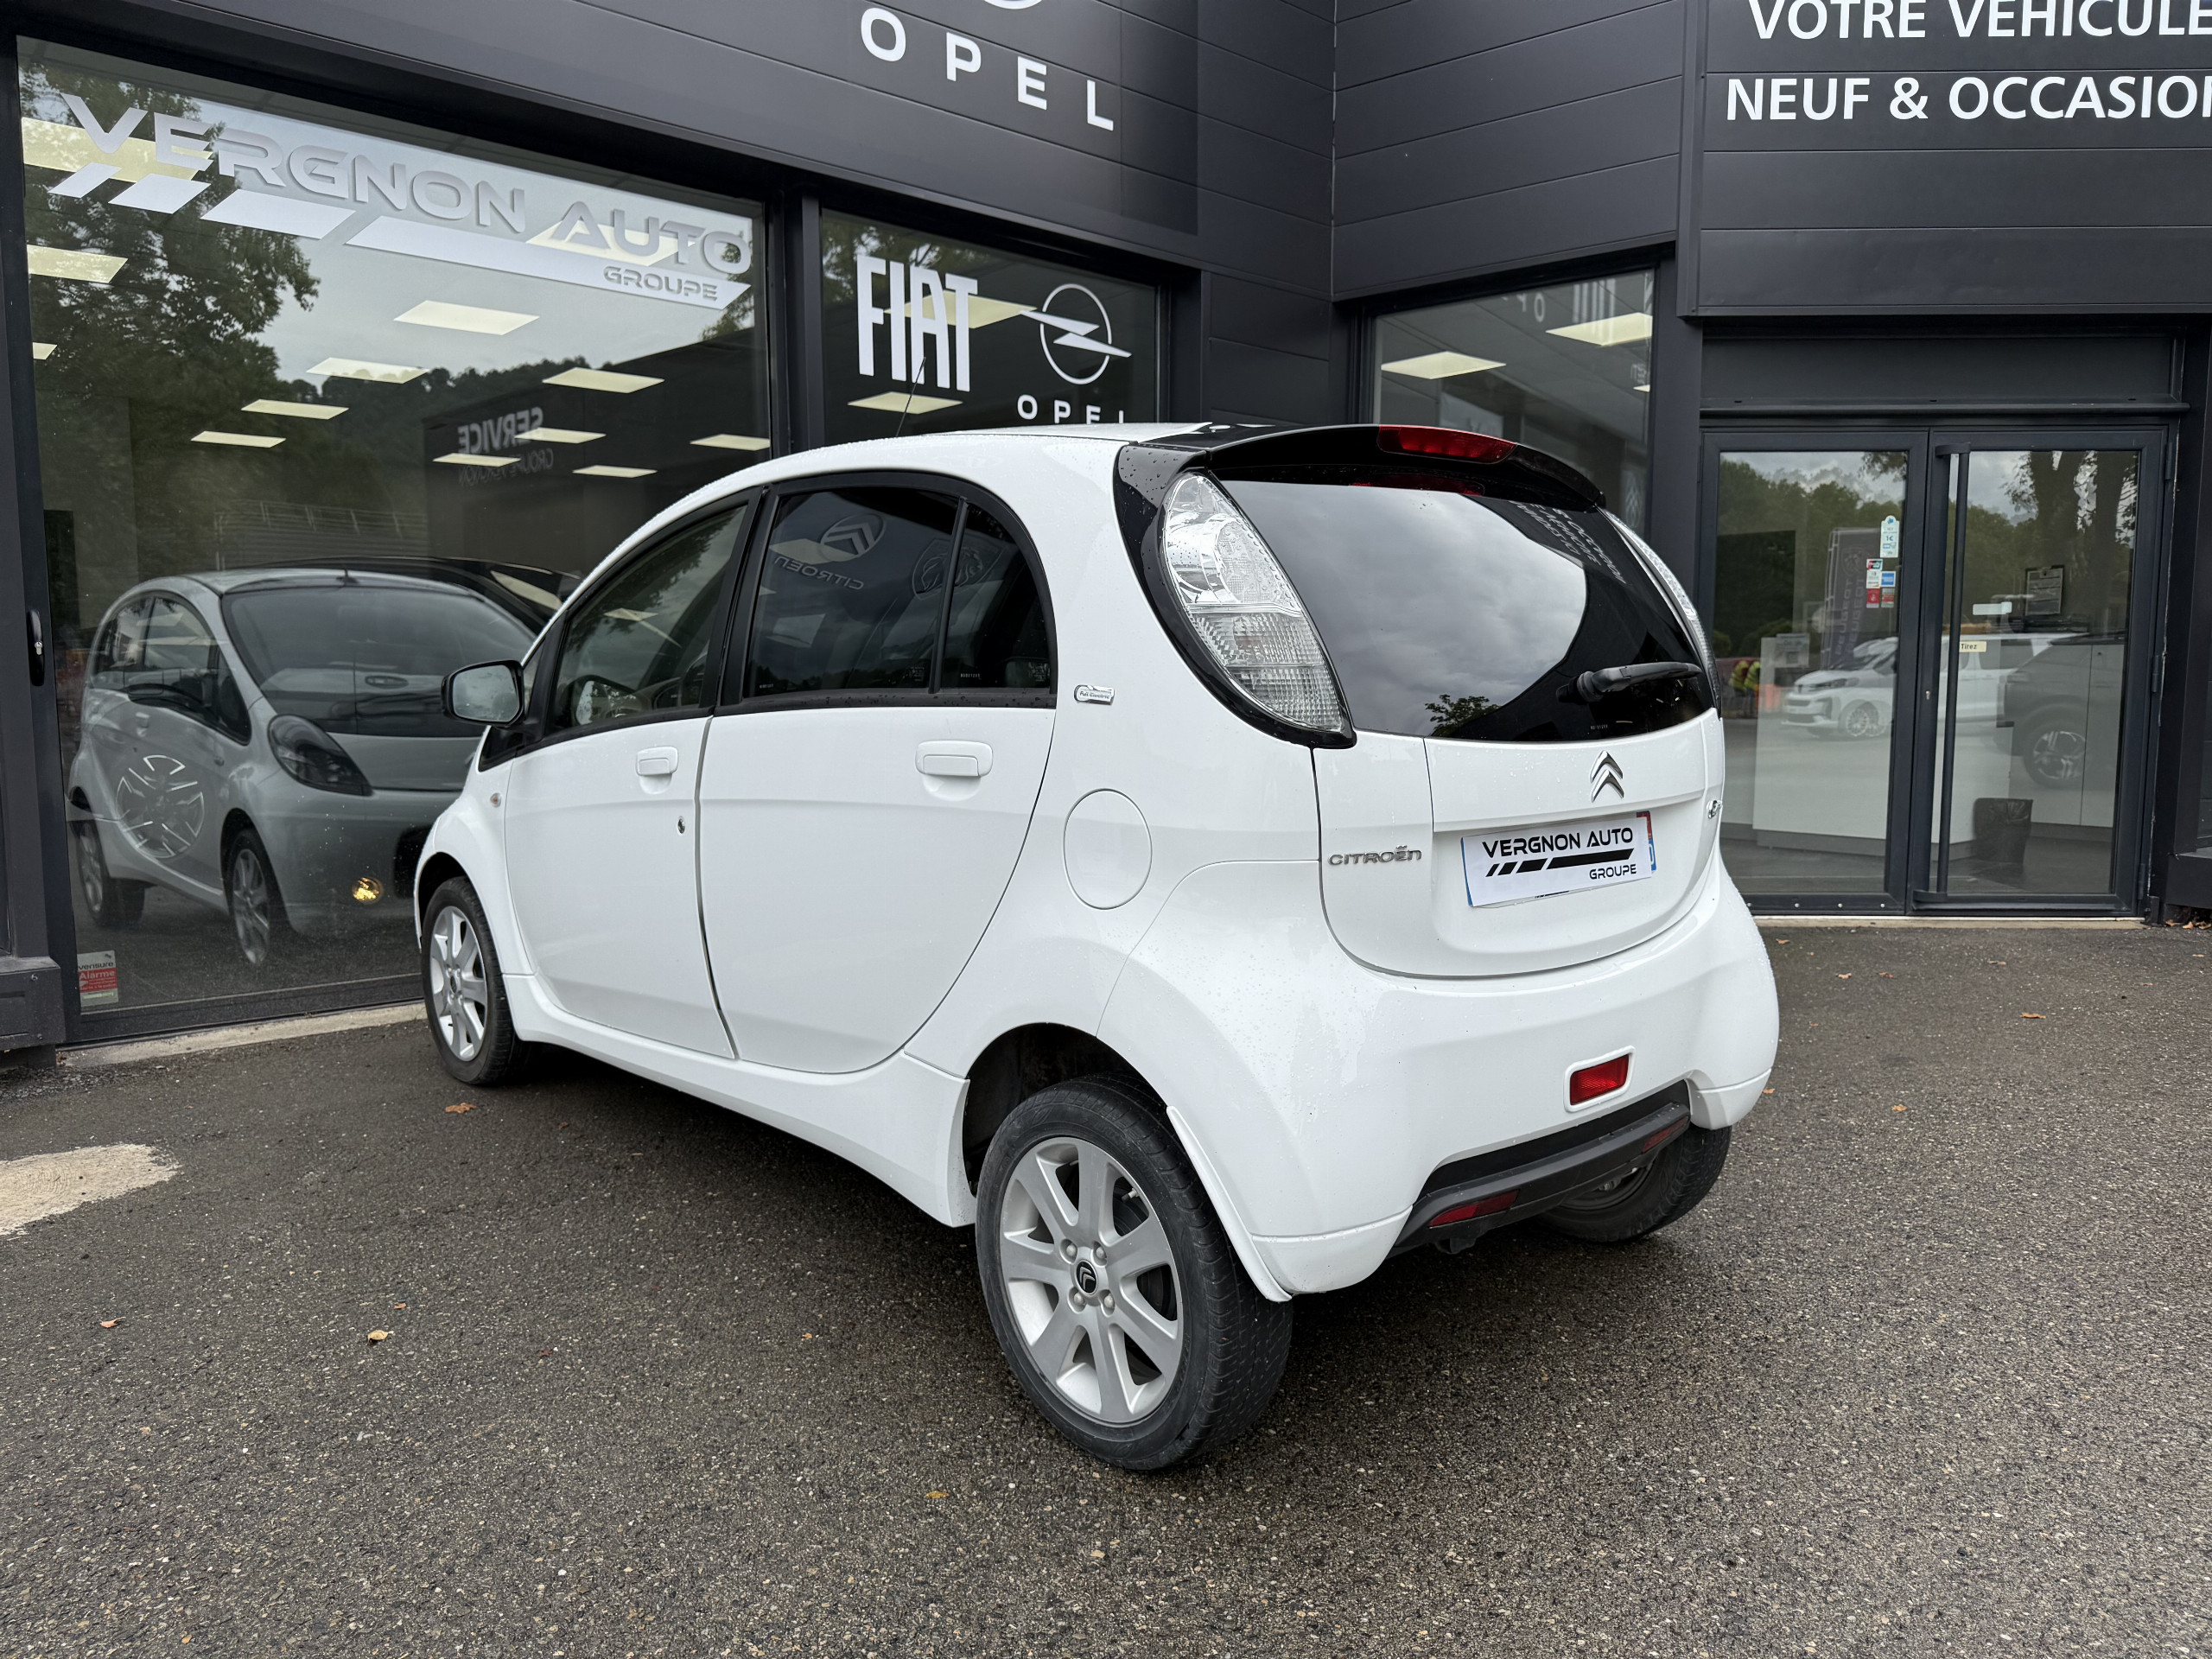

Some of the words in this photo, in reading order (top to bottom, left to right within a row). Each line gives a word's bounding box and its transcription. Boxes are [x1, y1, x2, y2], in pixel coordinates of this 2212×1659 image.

[1749, 0, 1927, 40] VOTRE
[860, 8, 1115, 131] OPEL
[1727, 77, 1871, 121] NEUF
[1890, 77, 1929, 120] &
[60, 92, 525, 233] VERGNON
[552, 200, 752, 274] AUTO
[603, 265, 718, 301] GROUPE
[856, 253, 978, 392] FIAT
[1481, 832, 1581, 859] VERGNON
[1586, 827, 1633, 848] AUTO
[1589, 864, 1637, 880] GROUPE
[78, 962, 114, 970] verisure
[79, 970, 115, 982] Alarme
